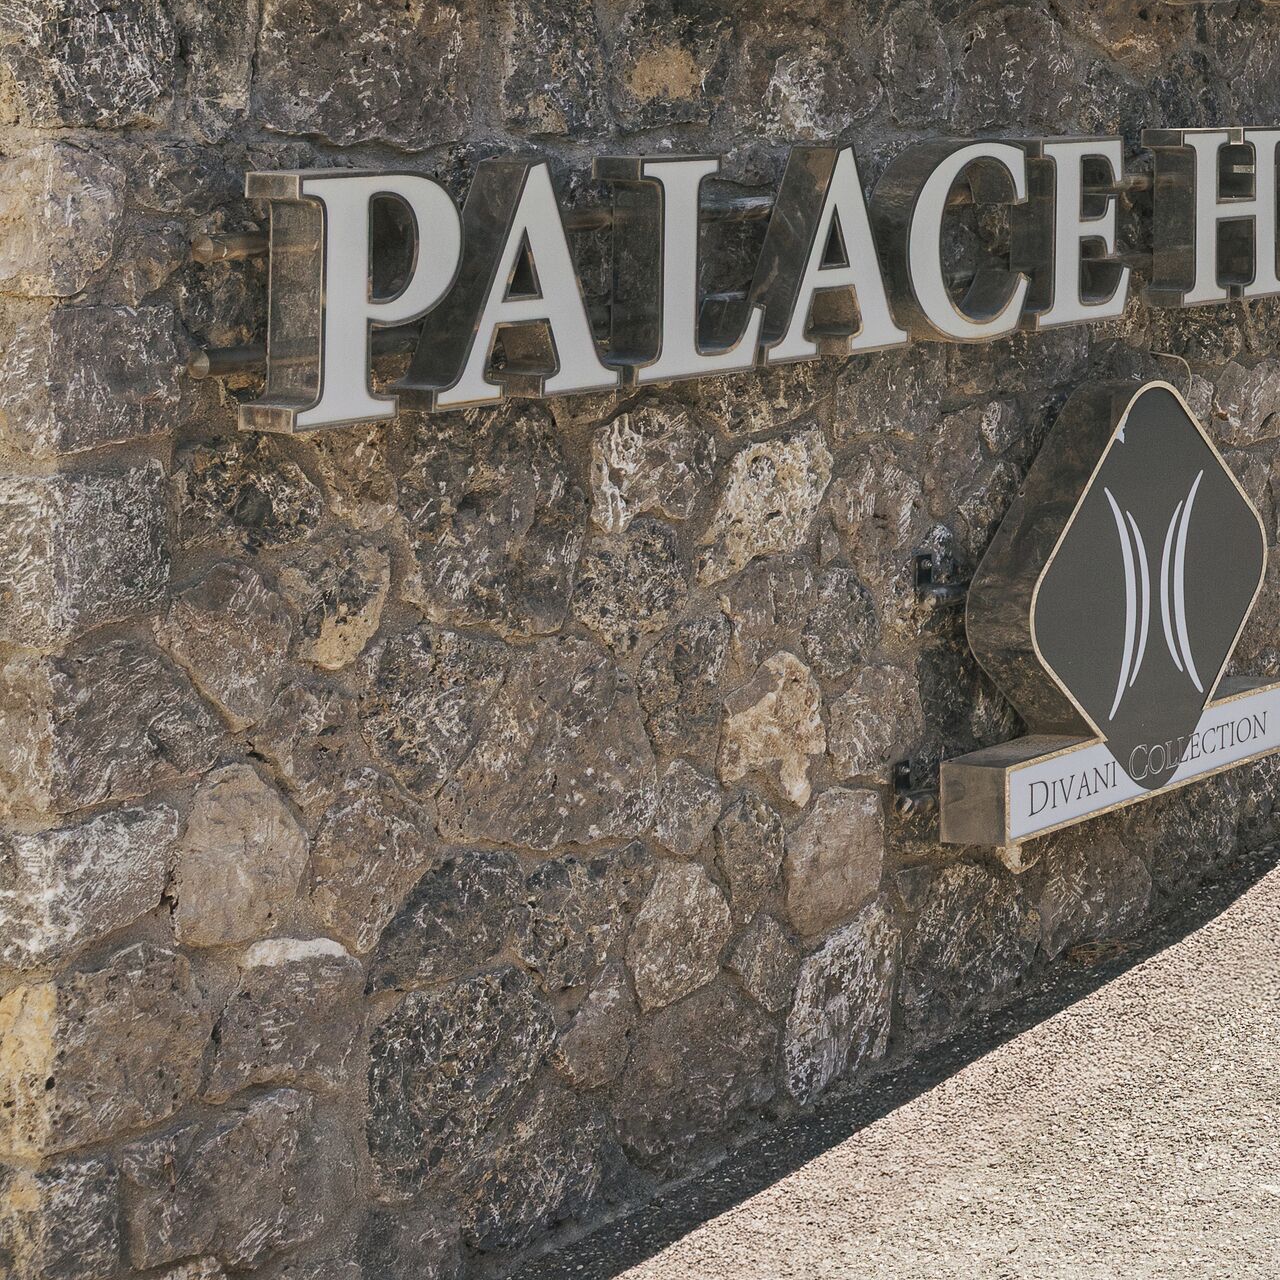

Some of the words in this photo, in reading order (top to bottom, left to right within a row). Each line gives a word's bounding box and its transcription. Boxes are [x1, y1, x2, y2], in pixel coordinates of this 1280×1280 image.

[292, 135, 1131, 433] PALACE
[1027, 760, 1118, 818] DIVANI
[1127, 710, 1269, 782] COLLECTION
